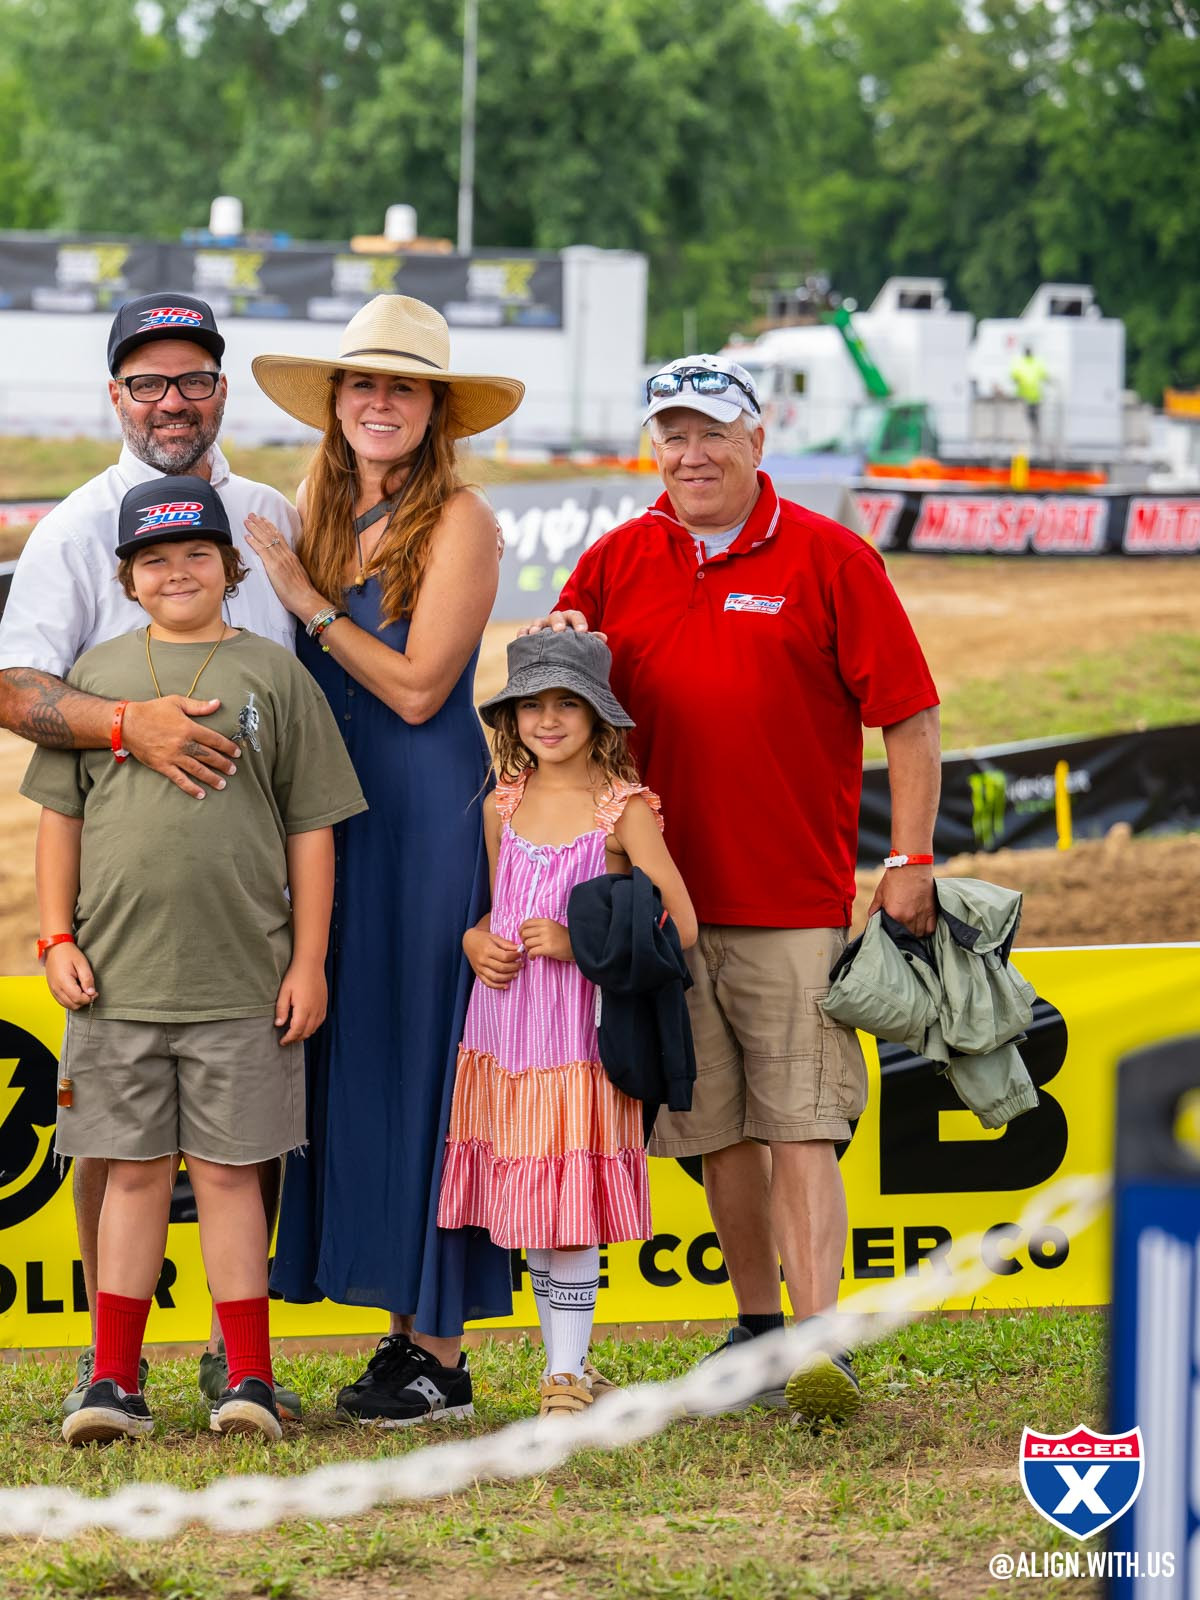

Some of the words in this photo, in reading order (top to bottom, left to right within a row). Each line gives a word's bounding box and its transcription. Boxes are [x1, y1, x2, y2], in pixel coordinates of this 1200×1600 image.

[137, 307, 204, 320] RED
[136, 502, 204, 517] RED
[550, 1290, 593, 1301] STANCE
